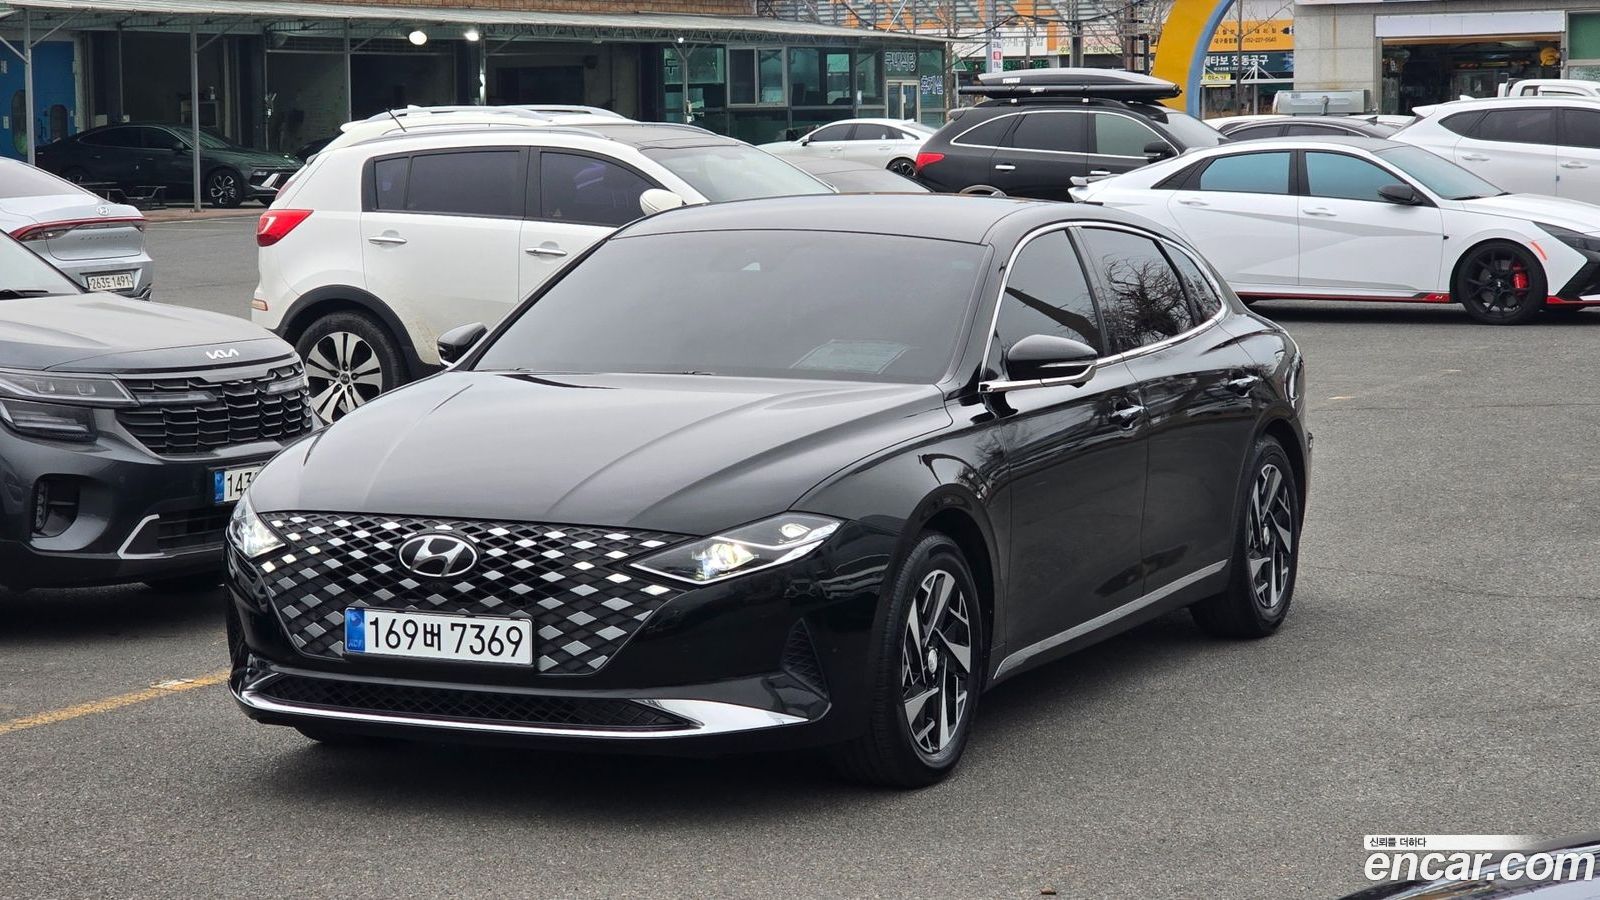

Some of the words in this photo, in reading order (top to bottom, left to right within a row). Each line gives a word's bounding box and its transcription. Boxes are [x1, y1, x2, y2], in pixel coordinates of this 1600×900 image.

[111, 275, 131, 287] 1491
[369, 617, 442, 652] 169버
[450, 622, 524, 658] 7369
